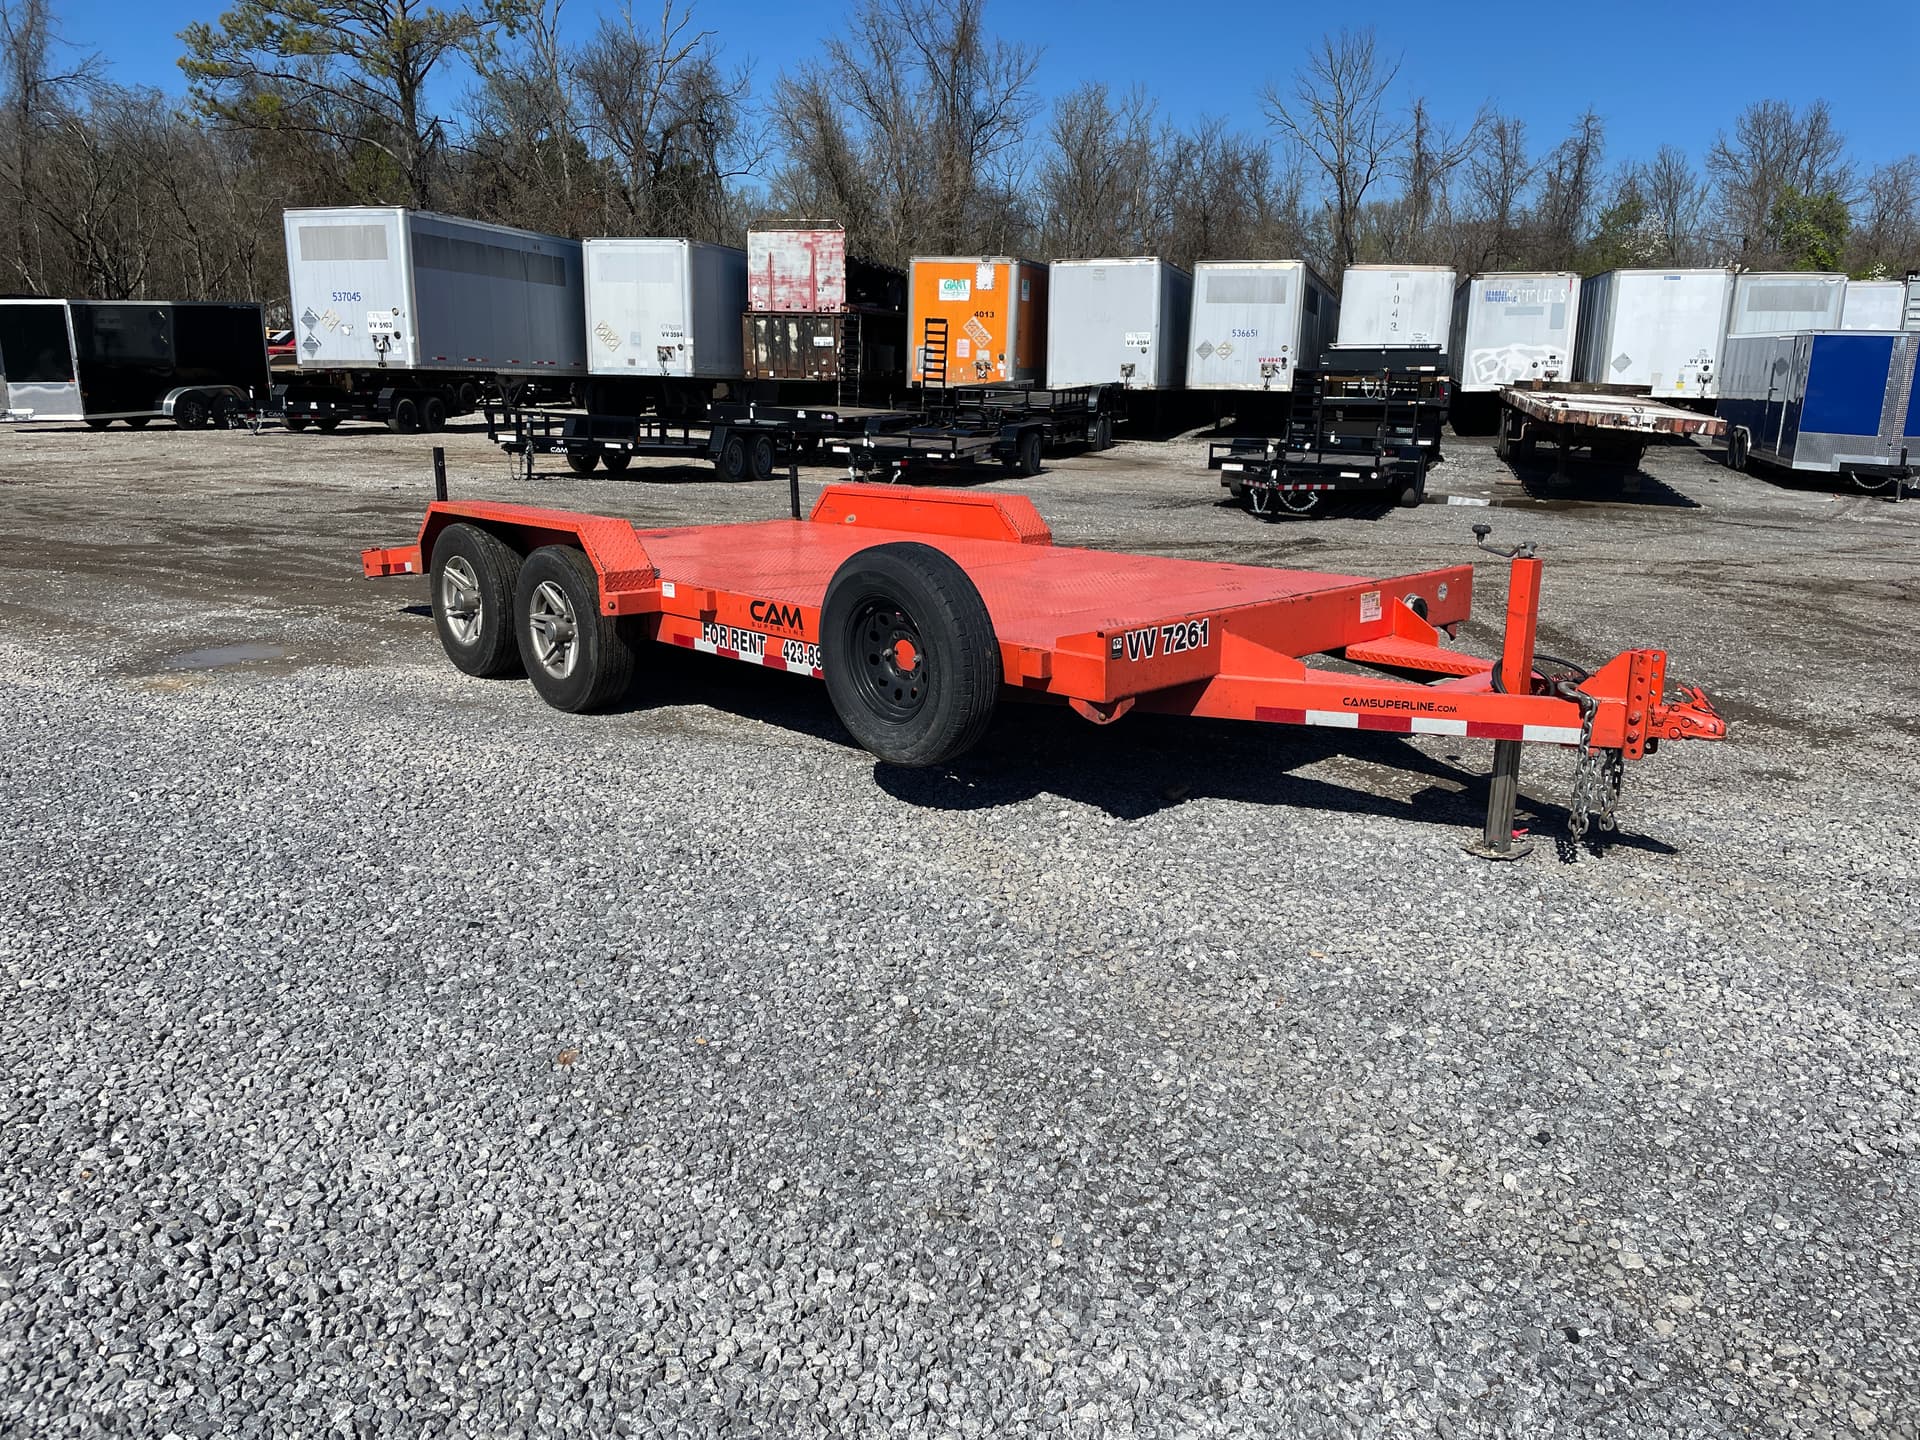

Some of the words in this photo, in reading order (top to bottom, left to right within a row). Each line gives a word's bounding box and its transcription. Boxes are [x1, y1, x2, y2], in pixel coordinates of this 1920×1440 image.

[332, 291, 361, 302] 537045
[974, 310, 995, 318] 4013
[1231, 328, 1258, 338] 536651
[550, 446, 569, 454] CAM
[750, 600, 803, 631] CAM
[751, 621, 805, 637] SUPERLINE
[702, 622, 728, 649] FOR
[731, 626, 767, 657] RENT
[1125, 627, 1158, 662] VV
[1161, 618, 1209, 655] 7261
[1342, 697, 1458, 713] CAMSUPERLINE.COM
